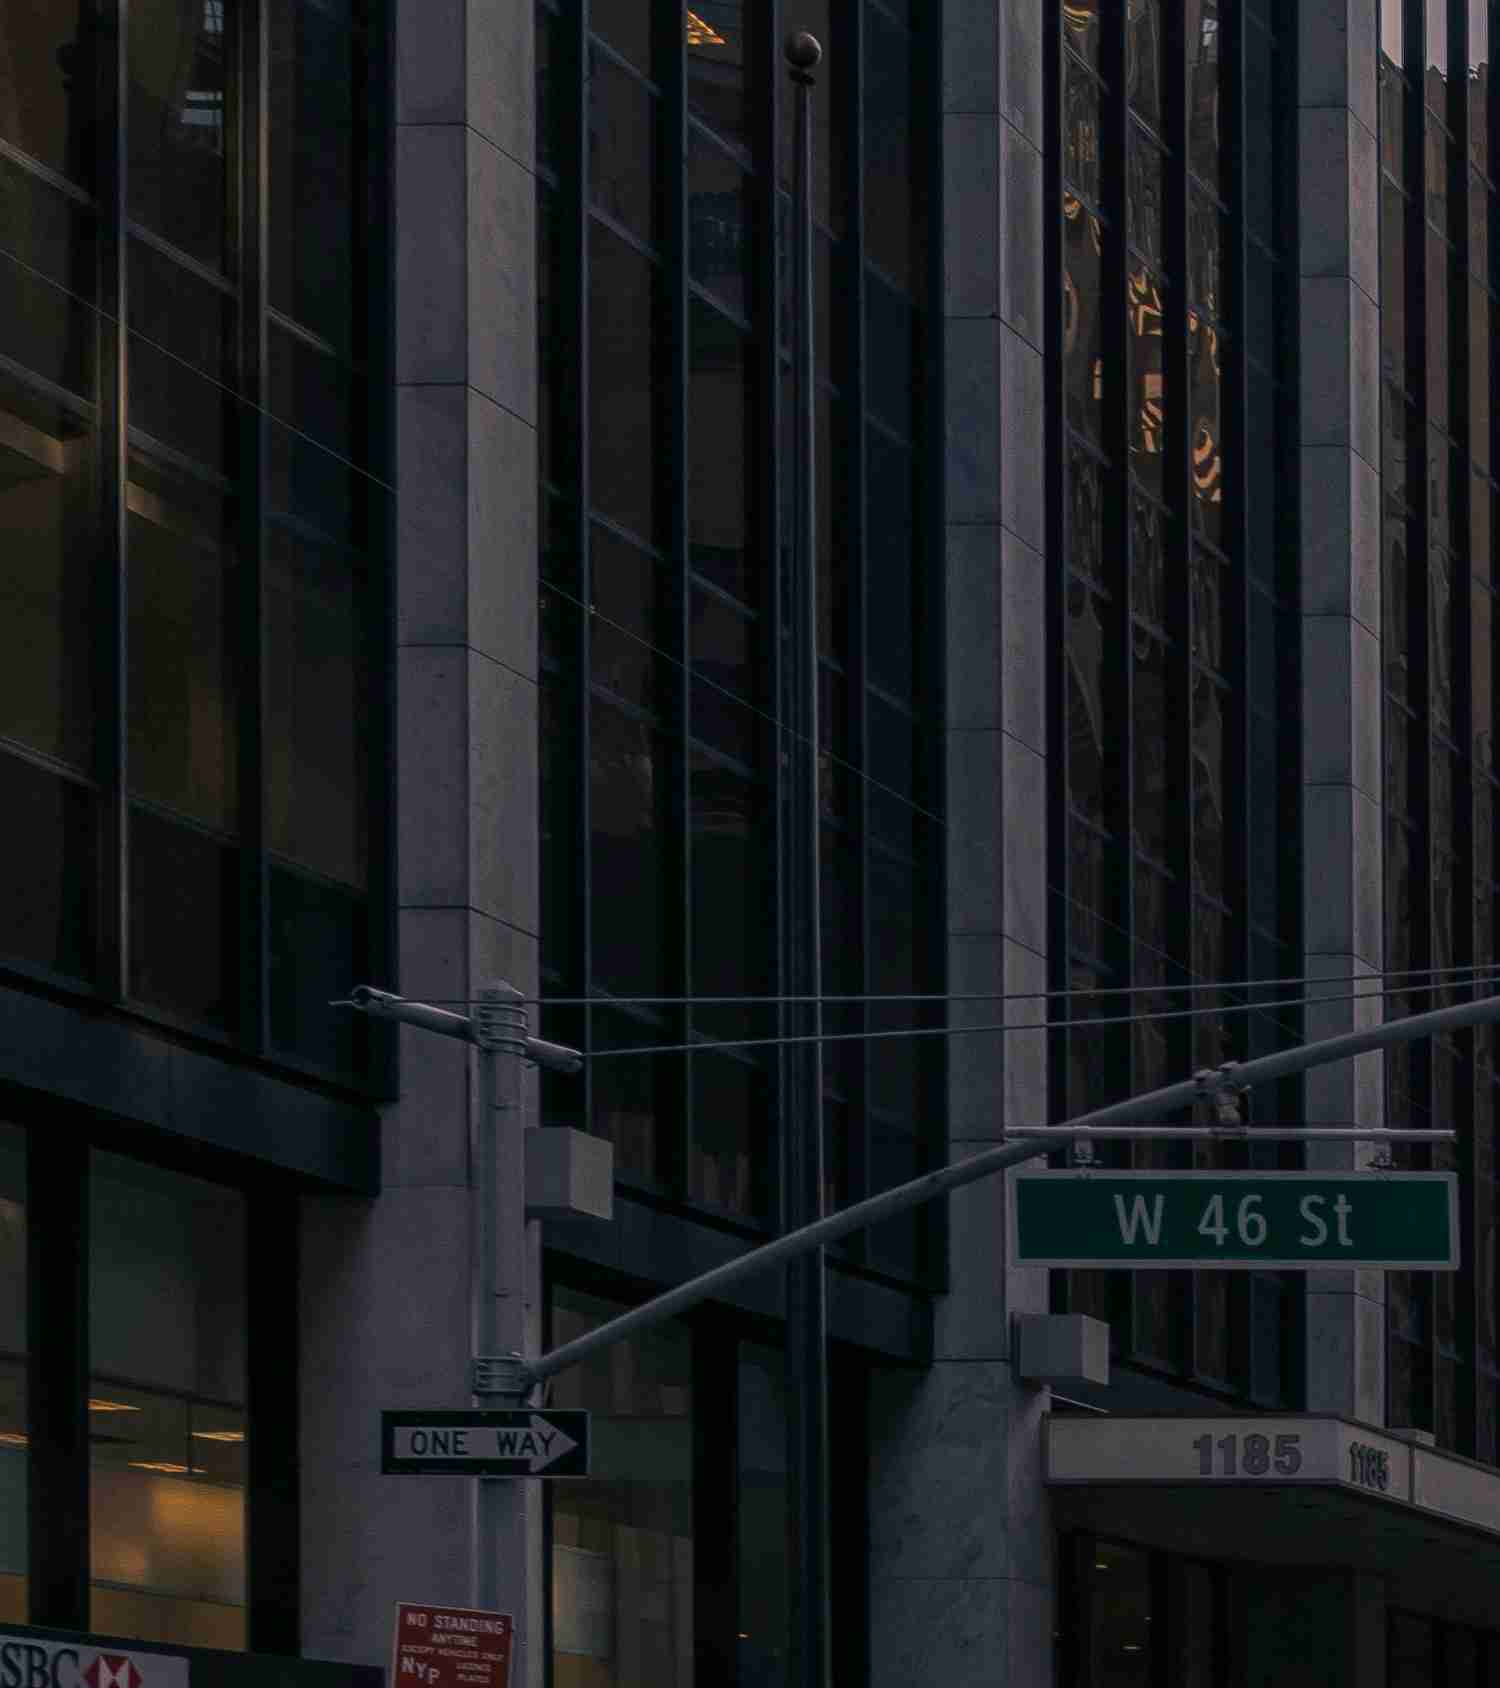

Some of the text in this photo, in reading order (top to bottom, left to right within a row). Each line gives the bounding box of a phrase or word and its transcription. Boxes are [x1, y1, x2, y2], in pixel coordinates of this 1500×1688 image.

[1113, 1193, 1355, 1248] W 46 St
[410, 1430, 555, 1456] ONE WAY
[1193, 1434, 1302, 1476] 1185
[406, 1611, 505, 1636] NO STANDING
[401, 1655, 441, 1685] NYP
